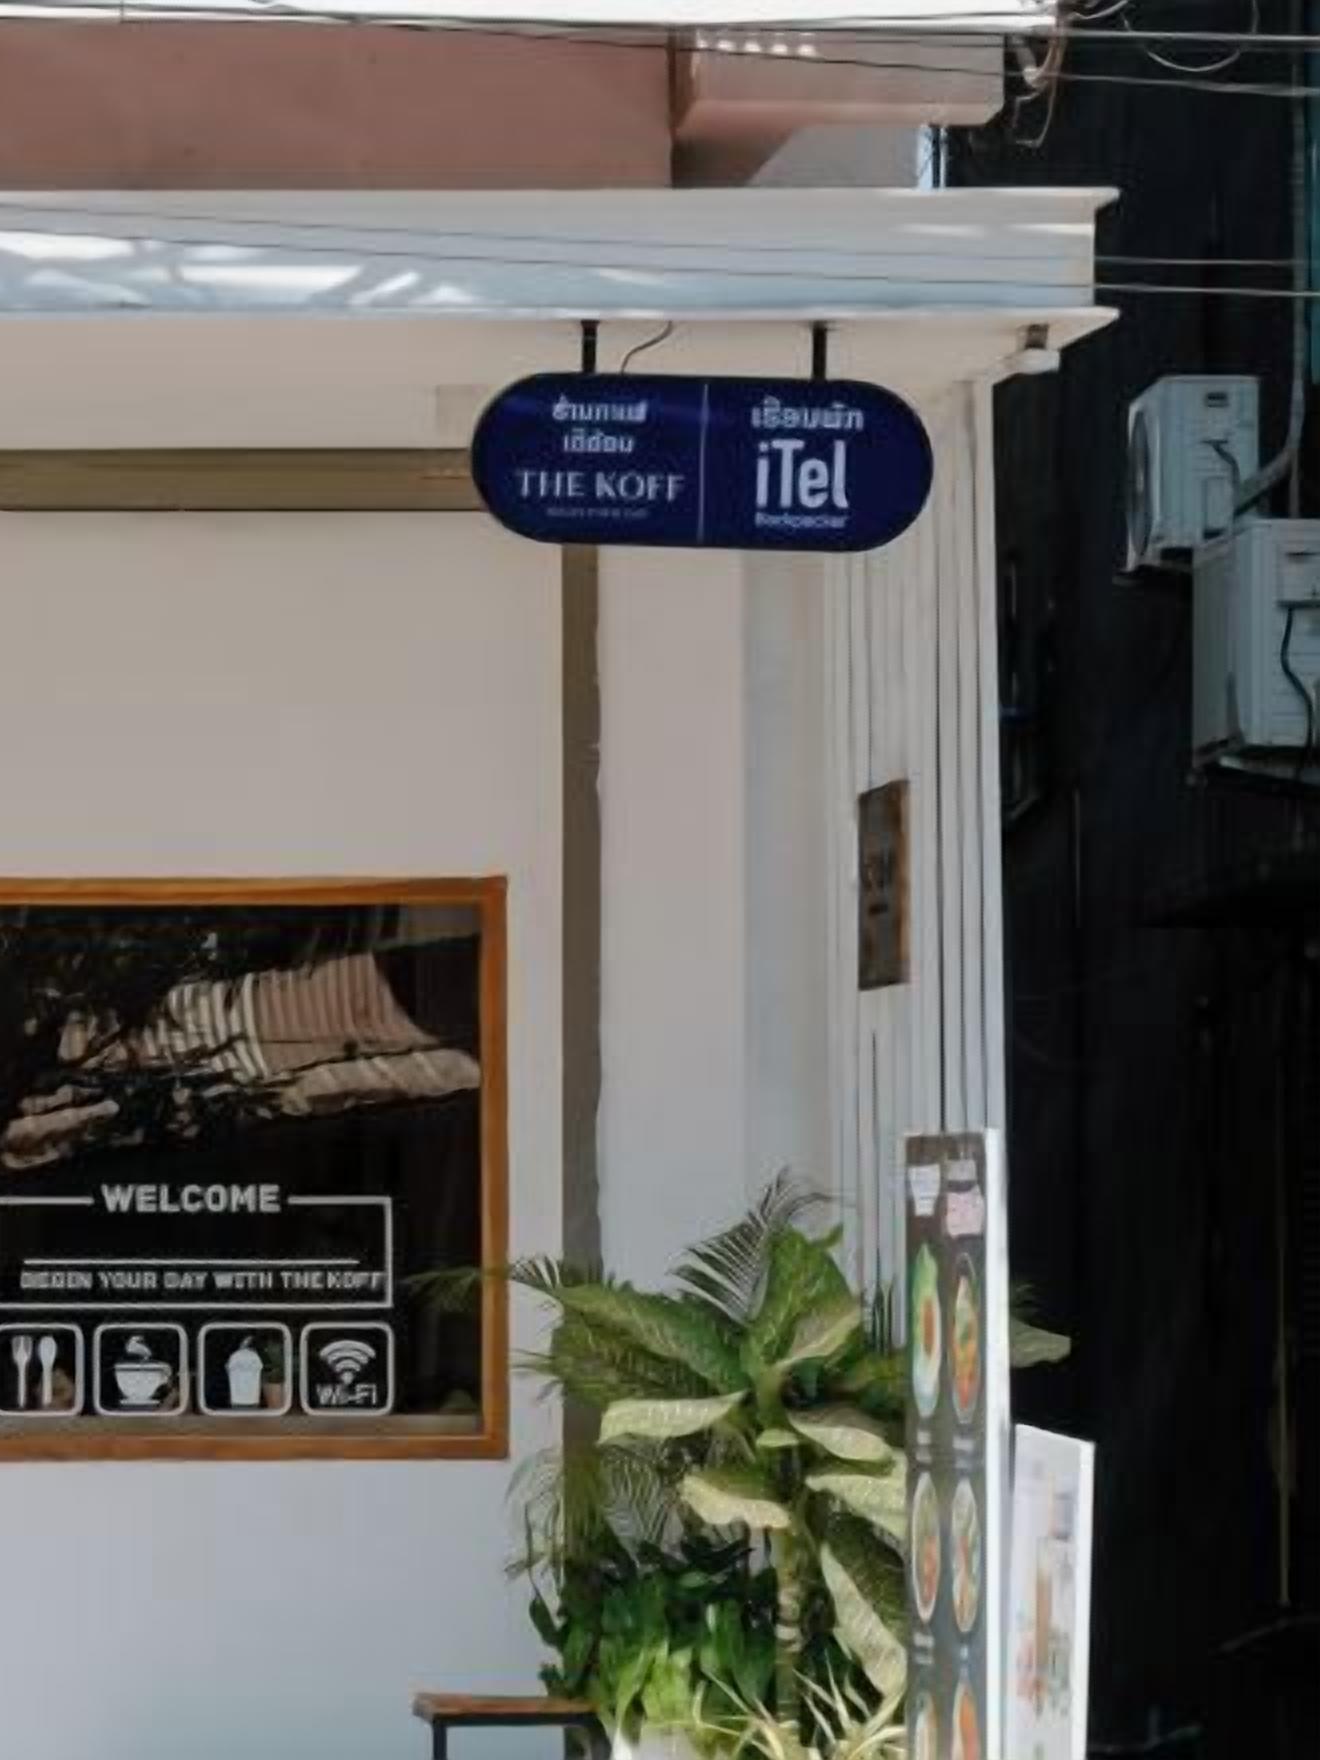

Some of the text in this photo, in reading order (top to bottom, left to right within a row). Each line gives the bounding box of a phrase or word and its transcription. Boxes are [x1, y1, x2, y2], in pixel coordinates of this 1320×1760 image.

[516, 470, 684, 502] THE KOFF
[757, 438, 849, 509] iTel
[101, 1184, 280, 1213] WELCOME
[97, 1271, 157, 1289] YOUR
[163, 1271, 208, 1289] DAY
[213, 1271, 273, 1289] WITH
